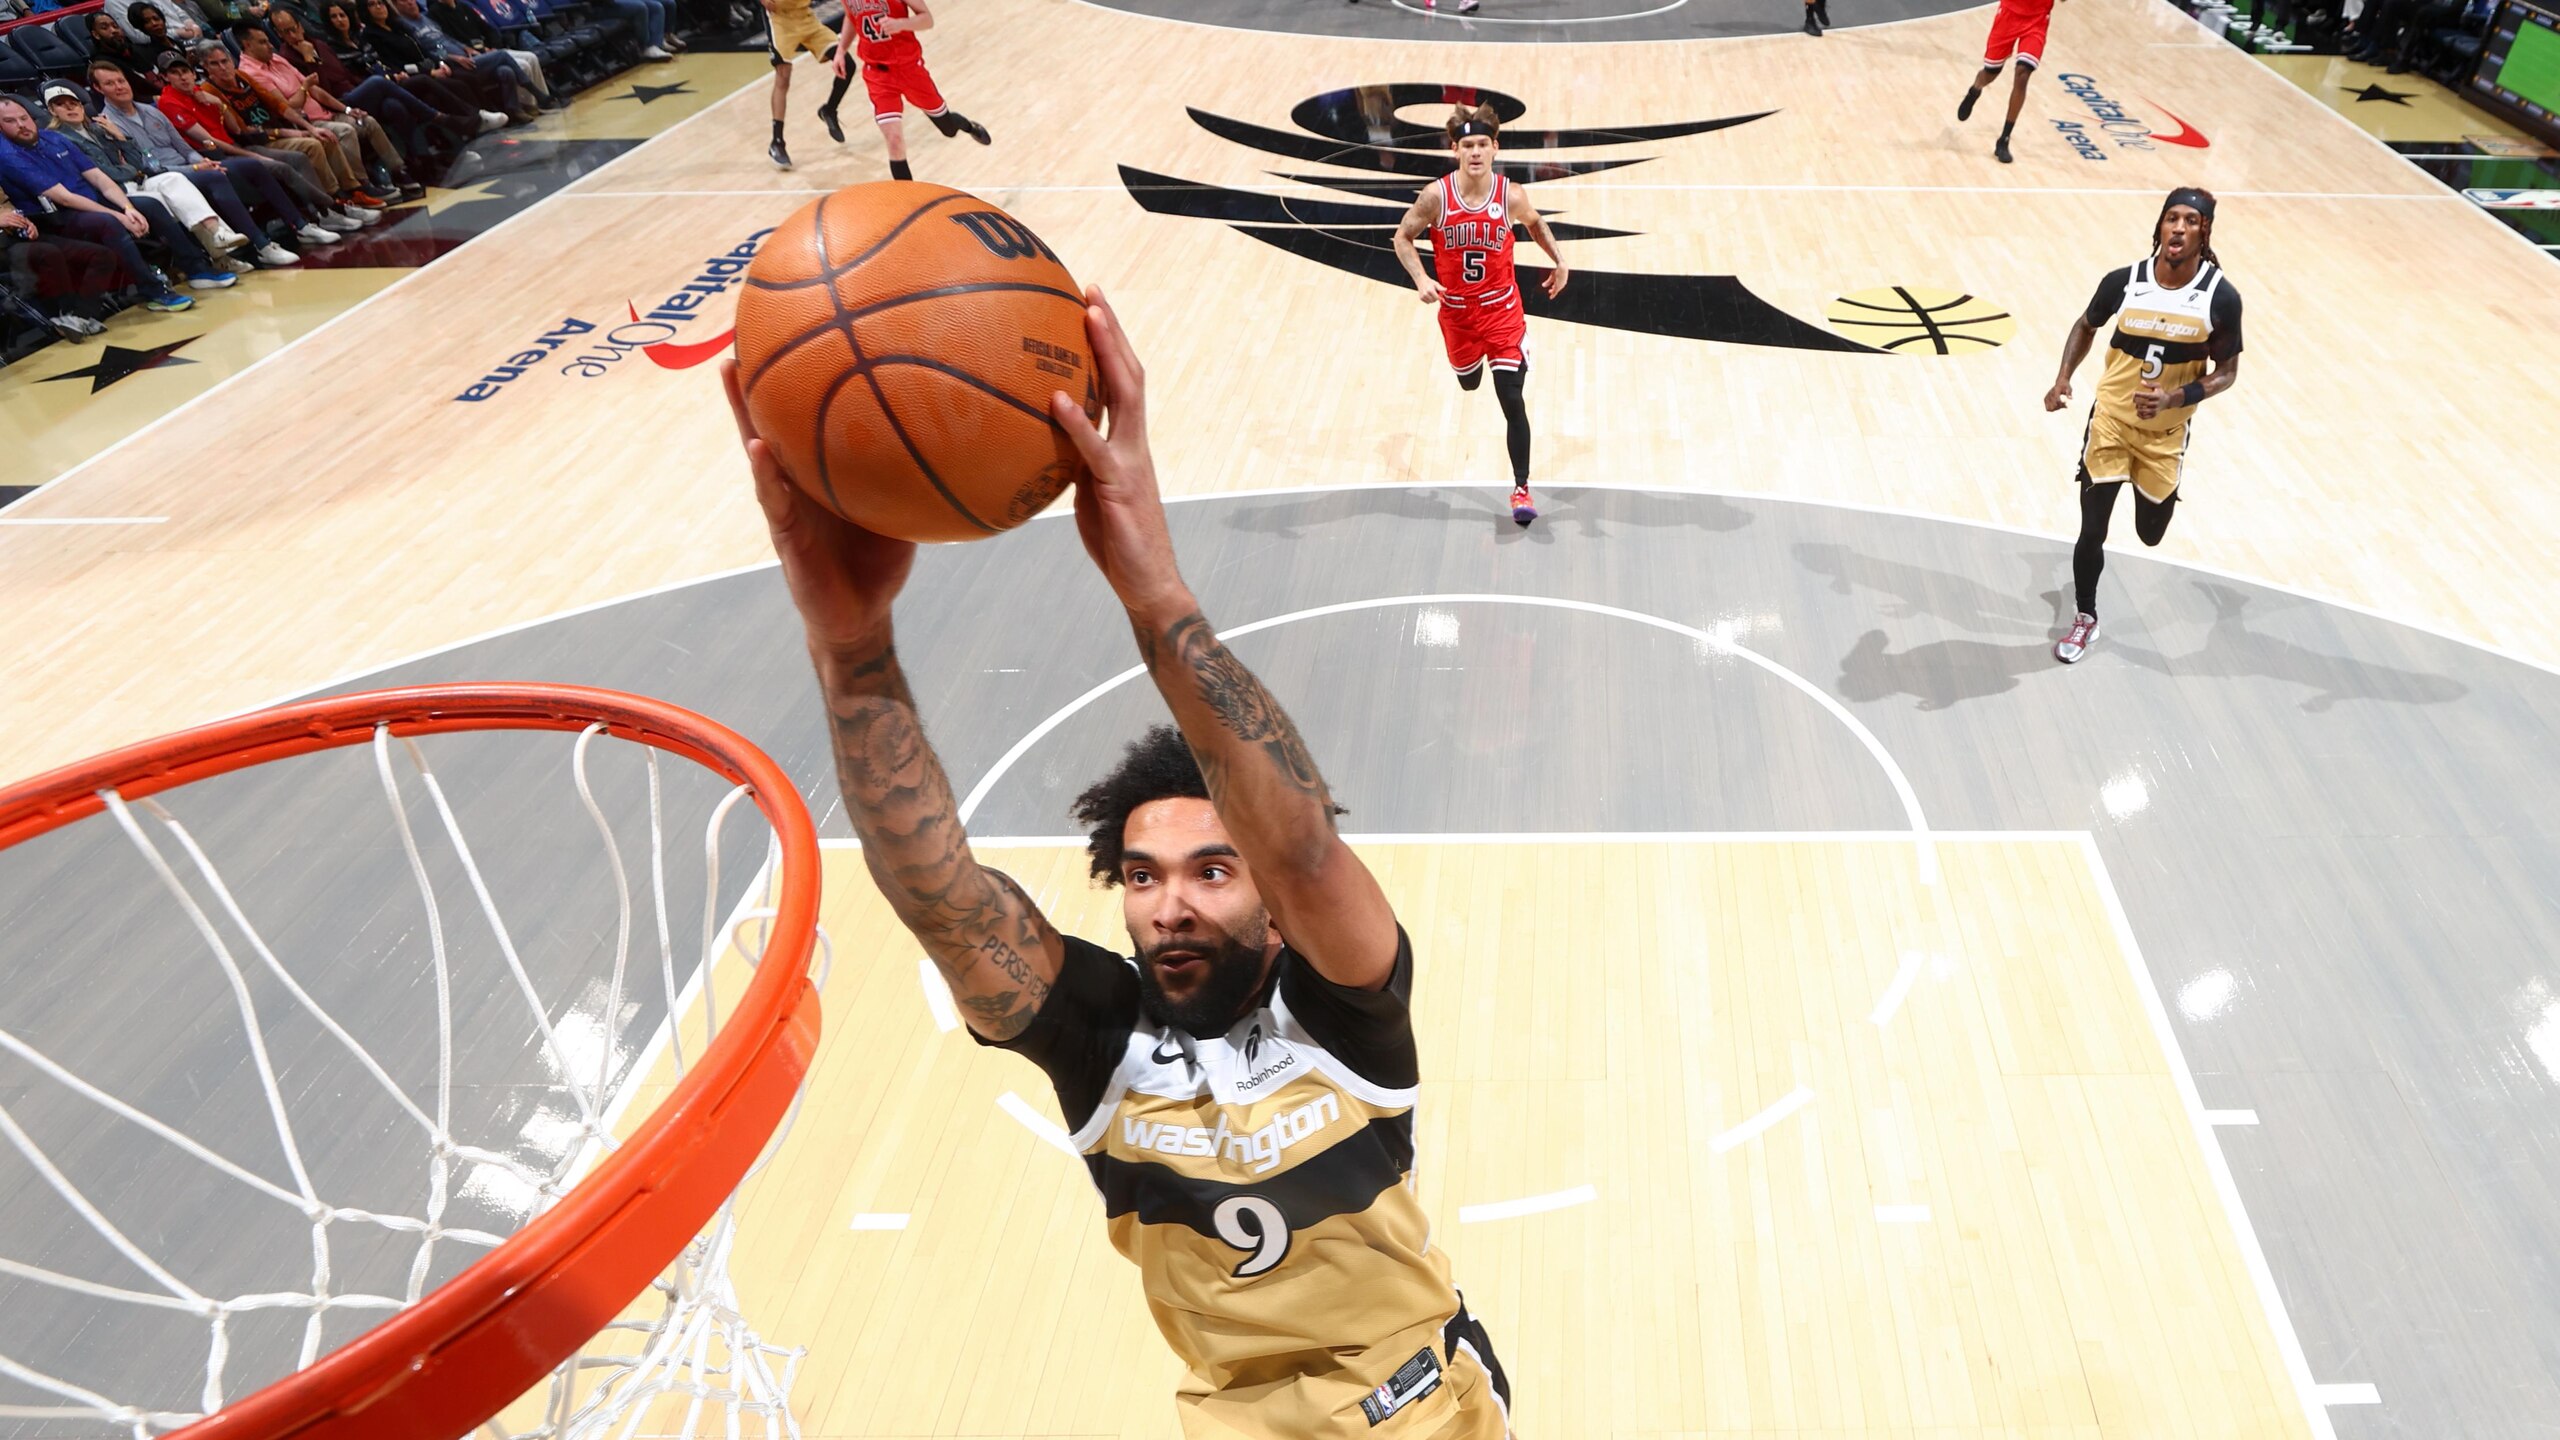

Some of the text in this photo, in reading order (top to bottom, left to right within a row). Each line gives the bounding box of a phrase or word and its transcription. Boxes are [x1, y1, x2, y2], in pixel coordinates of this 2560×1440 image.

[2057, 73, 2141, 123] Capital
[2049, 118, 2108, 161] Arena
[1443, 222, 1506, 251] BULLS
[1463, 250, 1487, 284] 5
[2124, 313, 2200, 337] washington
[452, 317, 598, 402] Arena
[2140, 343, 2166, 380] 5
[1236, 1053, 1296, 1093] Robinhood
[1123, 1092, 1341, 1175] washngton
[1211, 1194, 1293, 1278] 9
